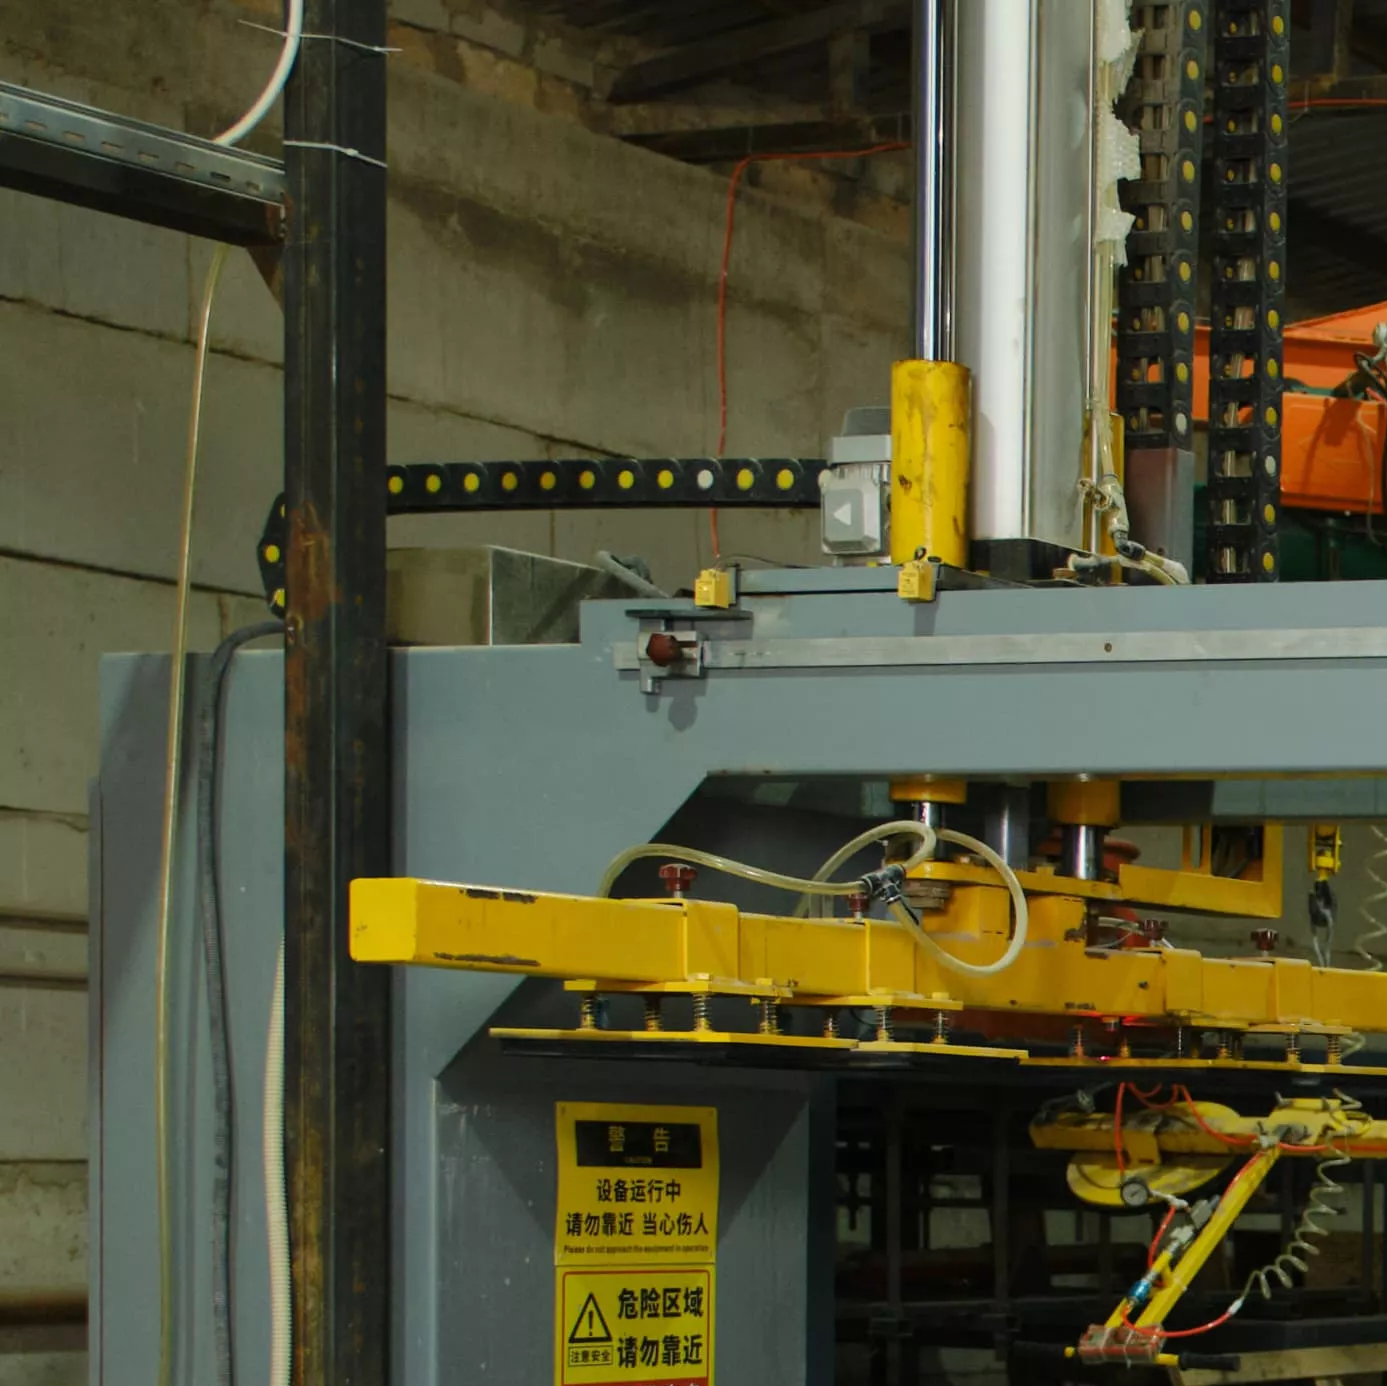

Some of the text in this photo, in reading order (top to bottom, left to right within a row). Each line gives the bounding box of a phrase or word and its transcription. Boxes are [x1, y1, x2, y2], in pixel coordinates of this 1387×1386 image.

[608, 1124, 671, 1153] 警告
[596, 1178, 681, 1203] 设备运行中
[566, 1212, 709, 1237] 请勿靠近 当心伤人
[617, 1287, 704, 1319] 危险区域
[570, 1349, 612, 1364] 注意安全
[617, 1334, 704, 1368] 请勿靠近
